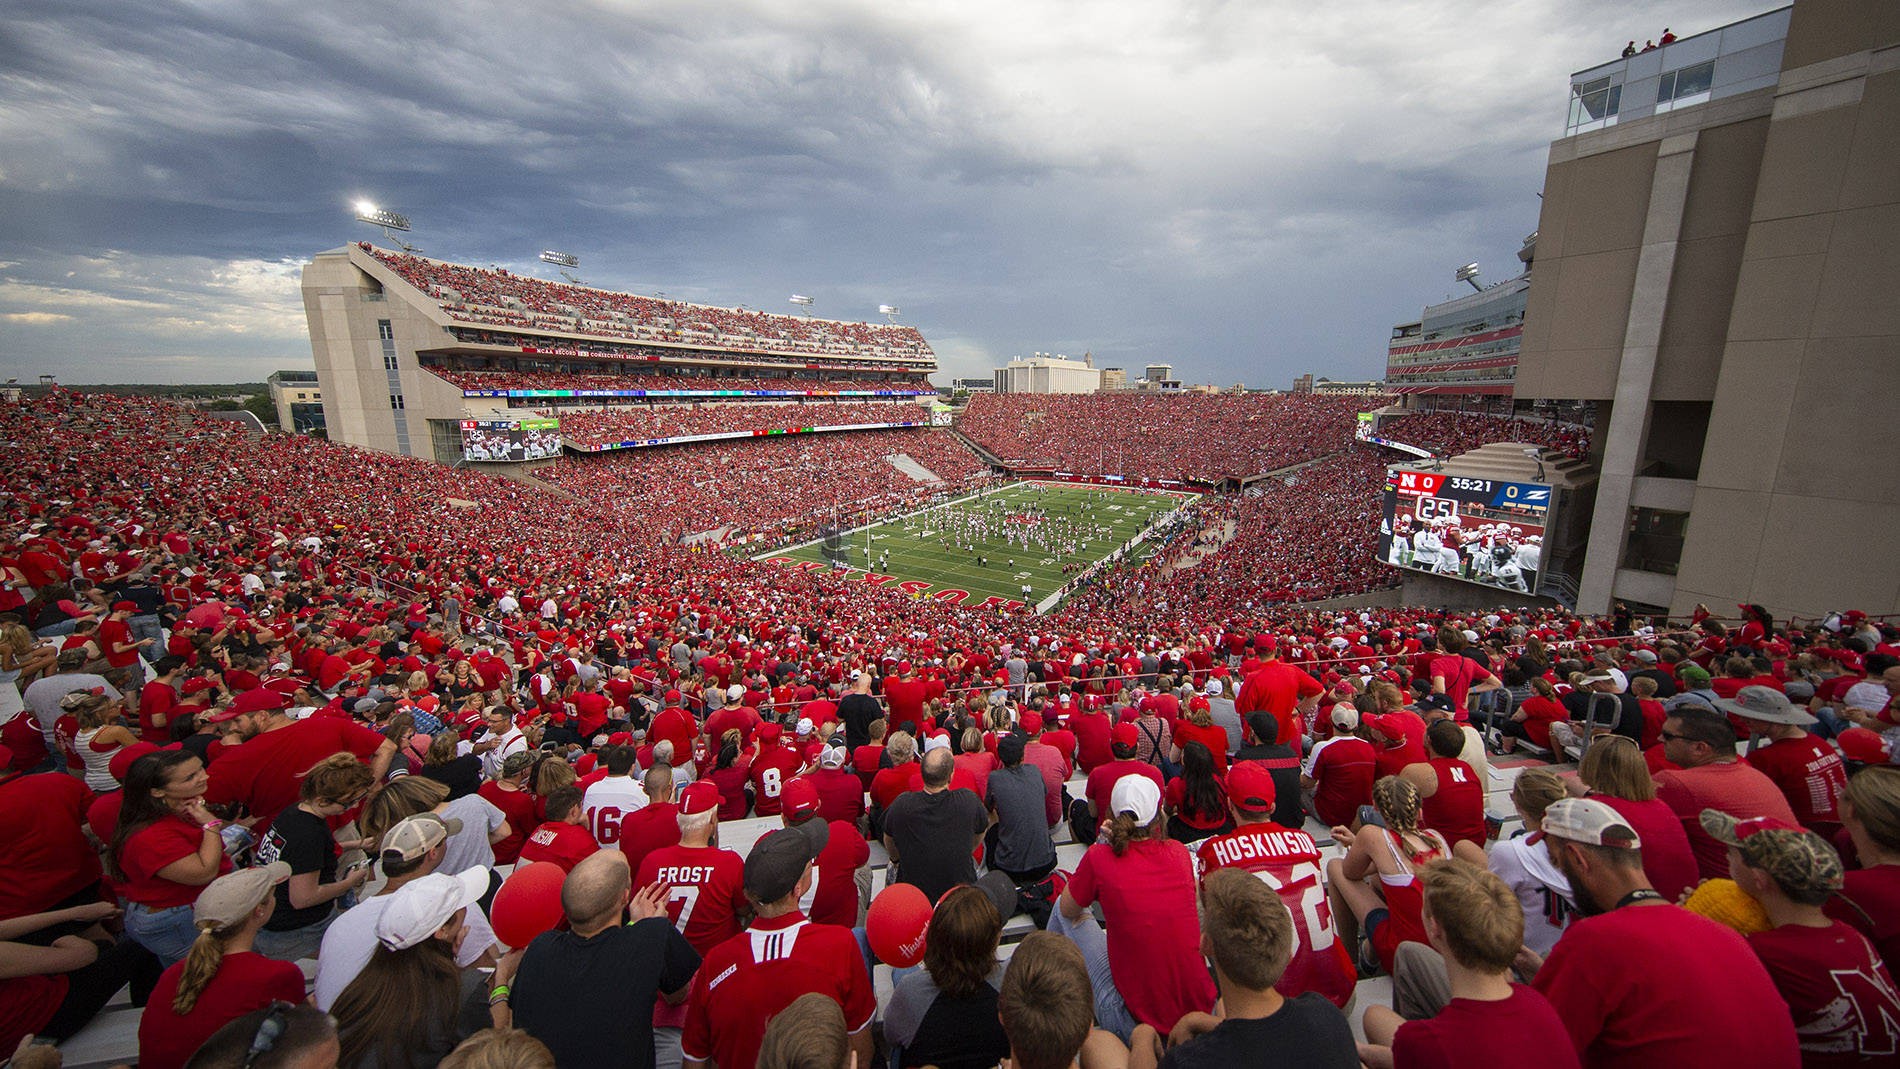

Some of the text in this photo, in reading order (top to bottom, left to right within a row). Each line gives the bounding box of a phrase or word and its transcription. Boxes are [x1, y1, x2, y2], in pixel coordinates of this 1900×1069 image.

[1400, 473, 1416, 488] N
[1423, 477, 1433, 489] 0
[1451, 477, 1491, 492] 35:21
[1506, 485, 1518, 499] 0
[1422, 499, 1450, 518] 25
[1291, 647, 1303, 658] N
[763, 767, 782, 798] 8
[1450, 767, 1467, 783] N
[587, 806, 621, 844] 16
[1212, 831, 1318, 866] HOSKINSON
[657, 866, 714, 884] FROST
[669, 886, 700, 935] 7
